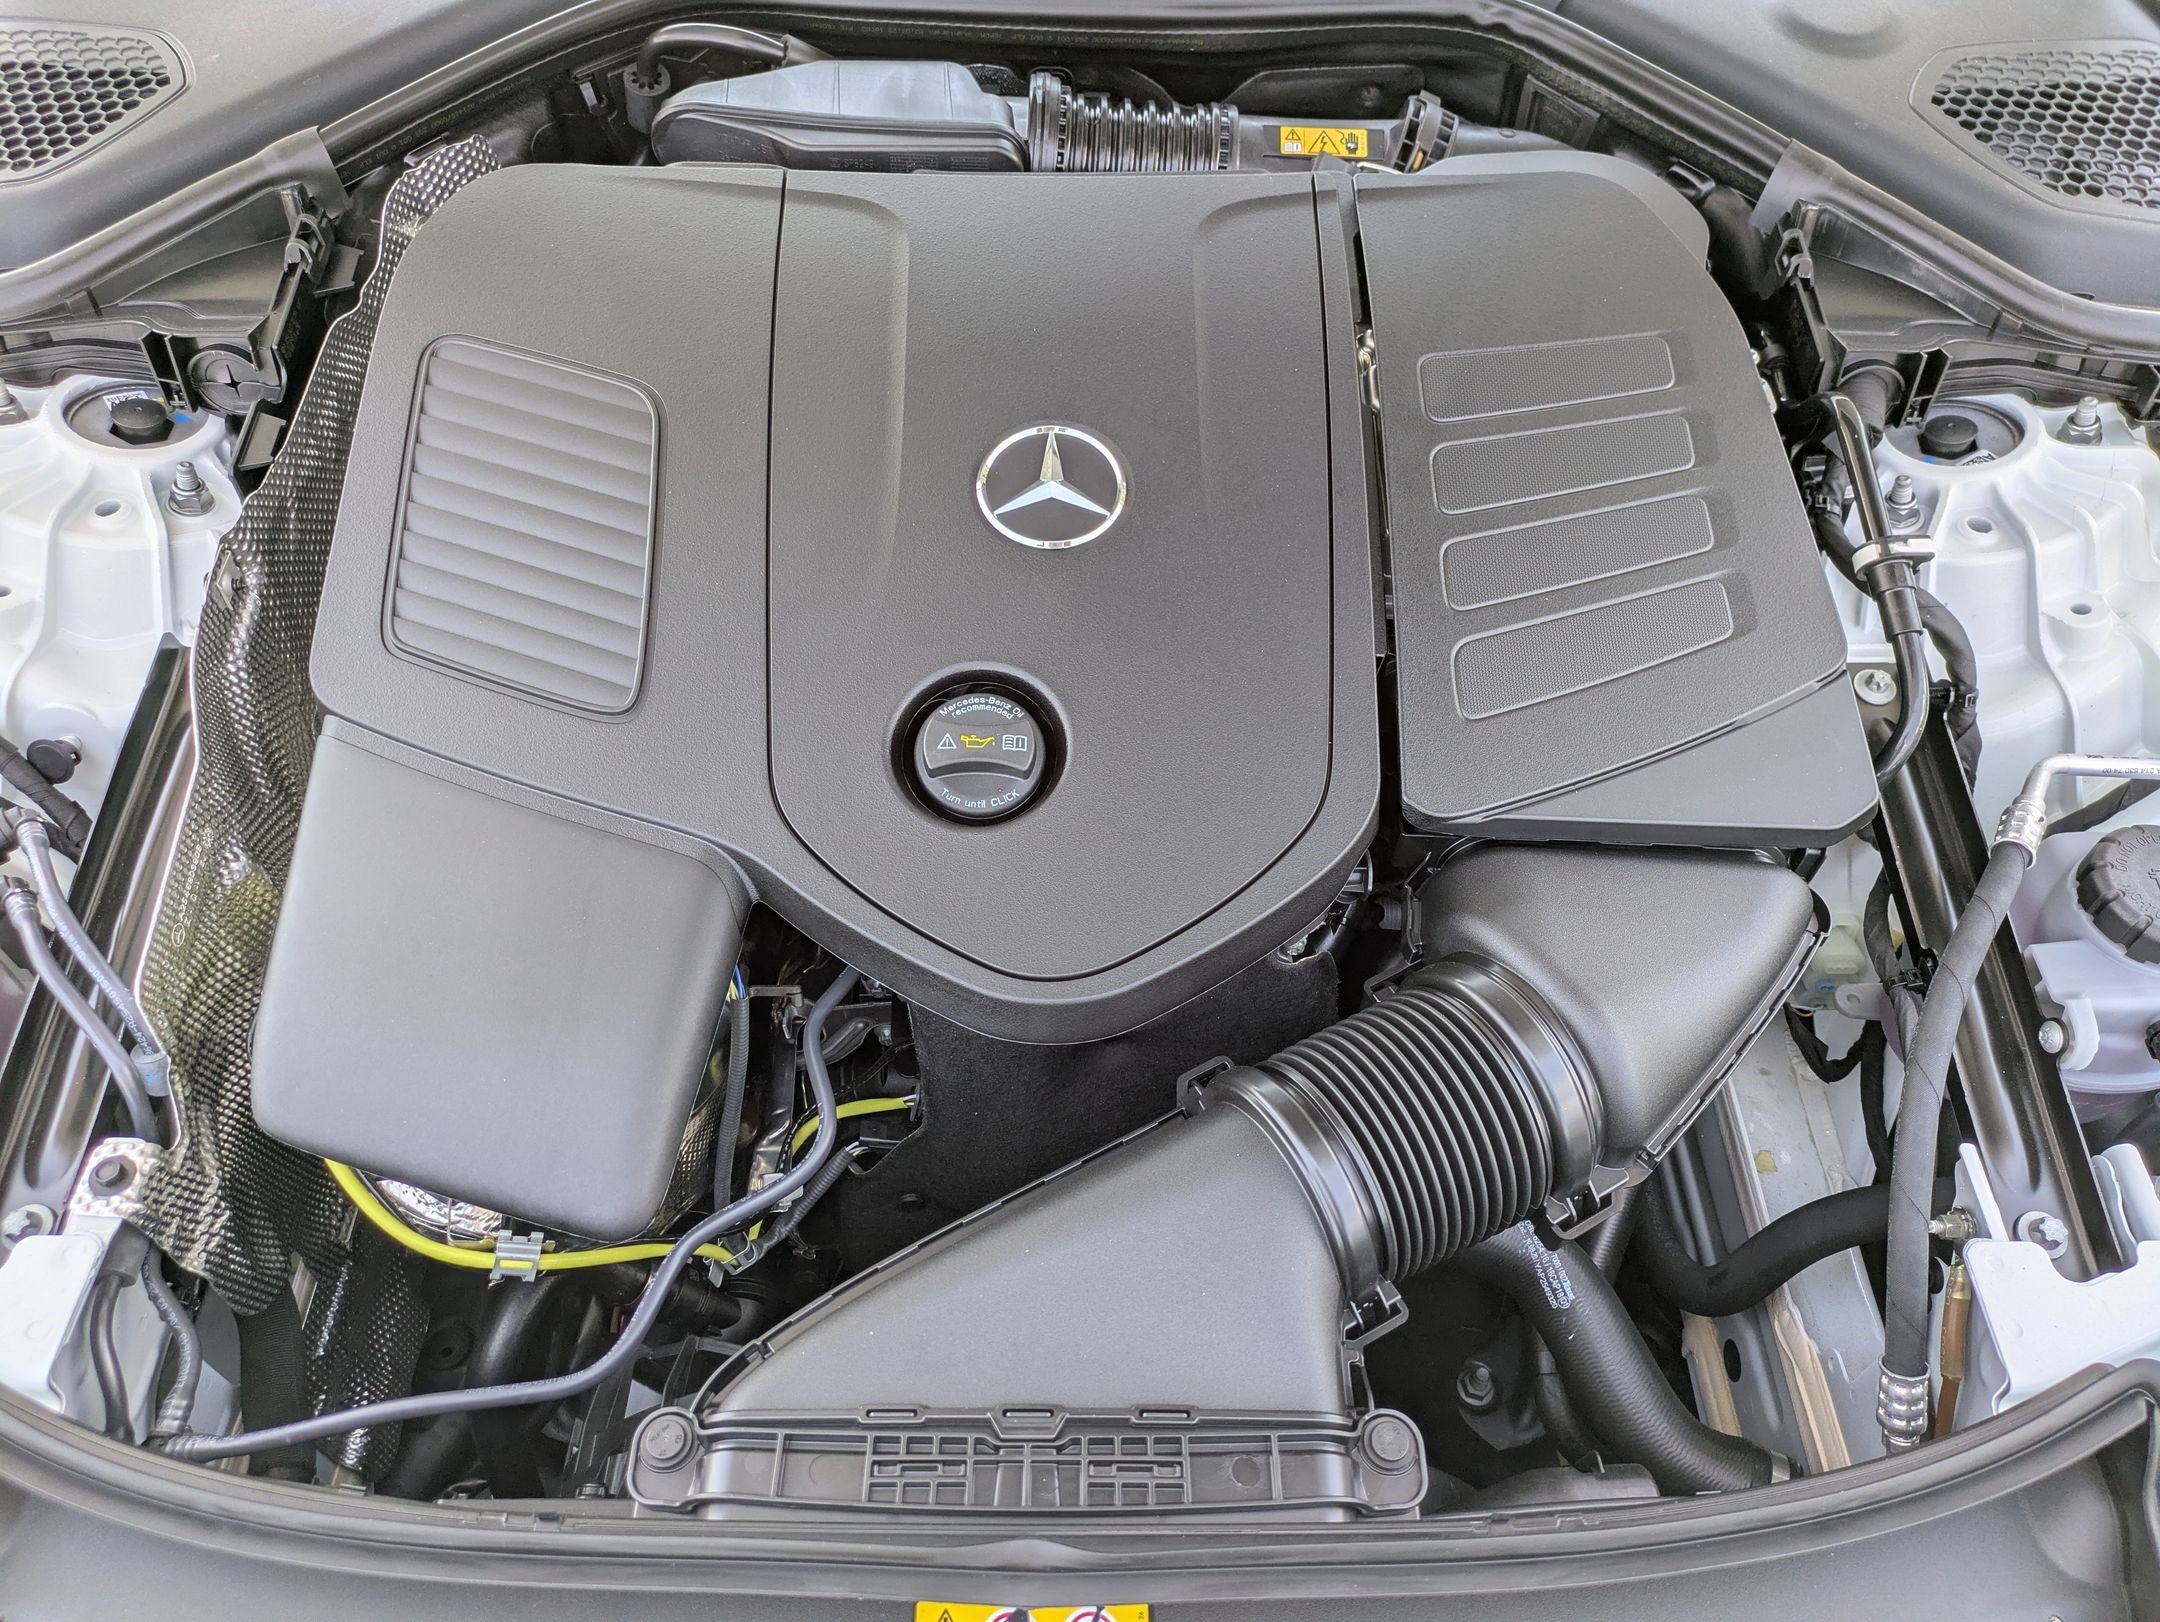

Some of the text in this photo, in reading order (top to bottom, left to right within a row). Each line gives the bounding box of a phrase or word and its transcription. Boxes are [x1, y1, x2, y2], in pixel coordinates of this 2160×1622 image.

[939, 696, 1025, 718] Mercedes-Benz Oil
[951, 704, 1015, 720] recommended
[941, 787, 1020, 809] Turn until CLICK
